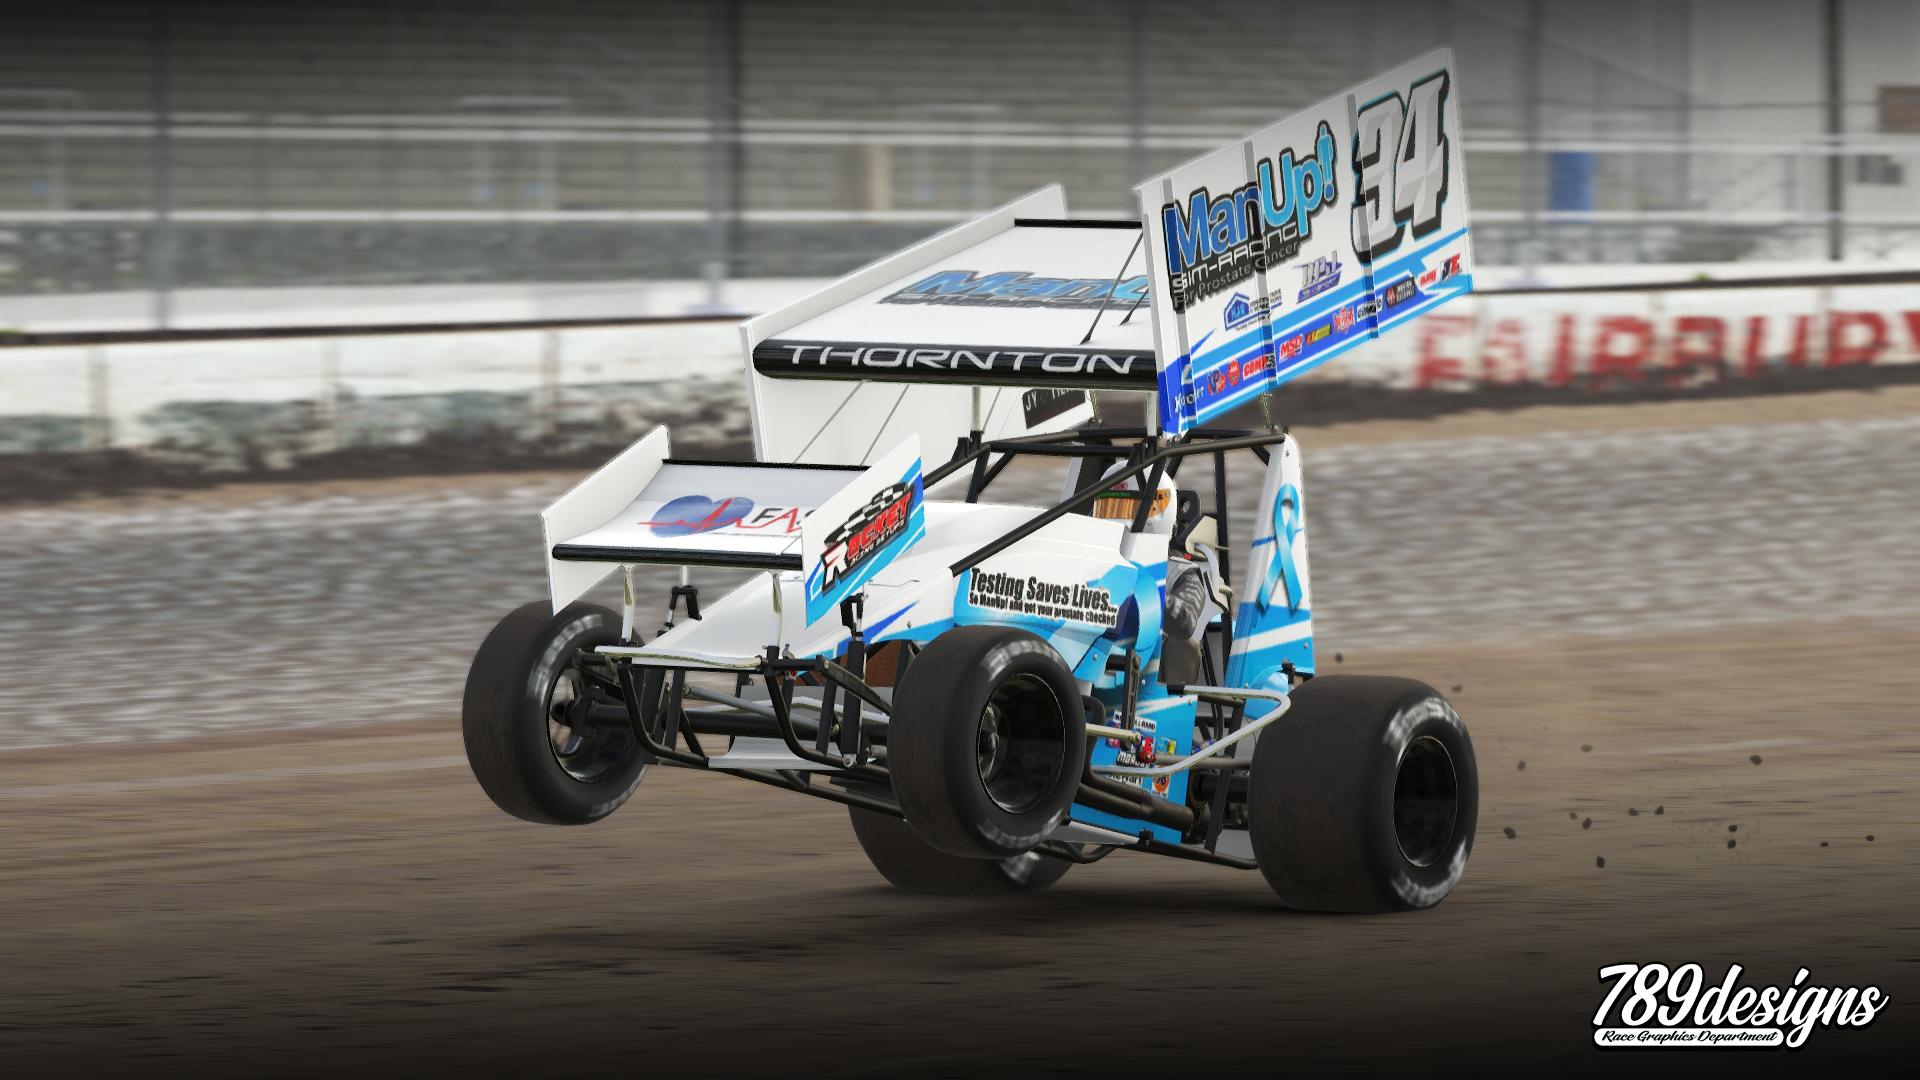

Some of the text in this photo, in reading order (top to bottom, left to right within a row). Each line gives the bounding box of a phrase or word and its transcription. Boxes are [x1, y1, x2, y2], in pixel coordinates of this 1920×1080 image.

[1352, 69, 1450, 263] 34
[1198, 262, 1251, 300] Prostate
[782, 344, 1136, 375] THORNTON
[971, 567, 1024, 600] Testing
[1026, 576, 1070, 605] Saves
[1009, 600, 1023, 612] and
[1024, 602, 1036, 614] get
[1037, 604, 1053, 616] your
[1054, 607, 1084, 621] prostate
[1085, 610, 1116, 626] checked
